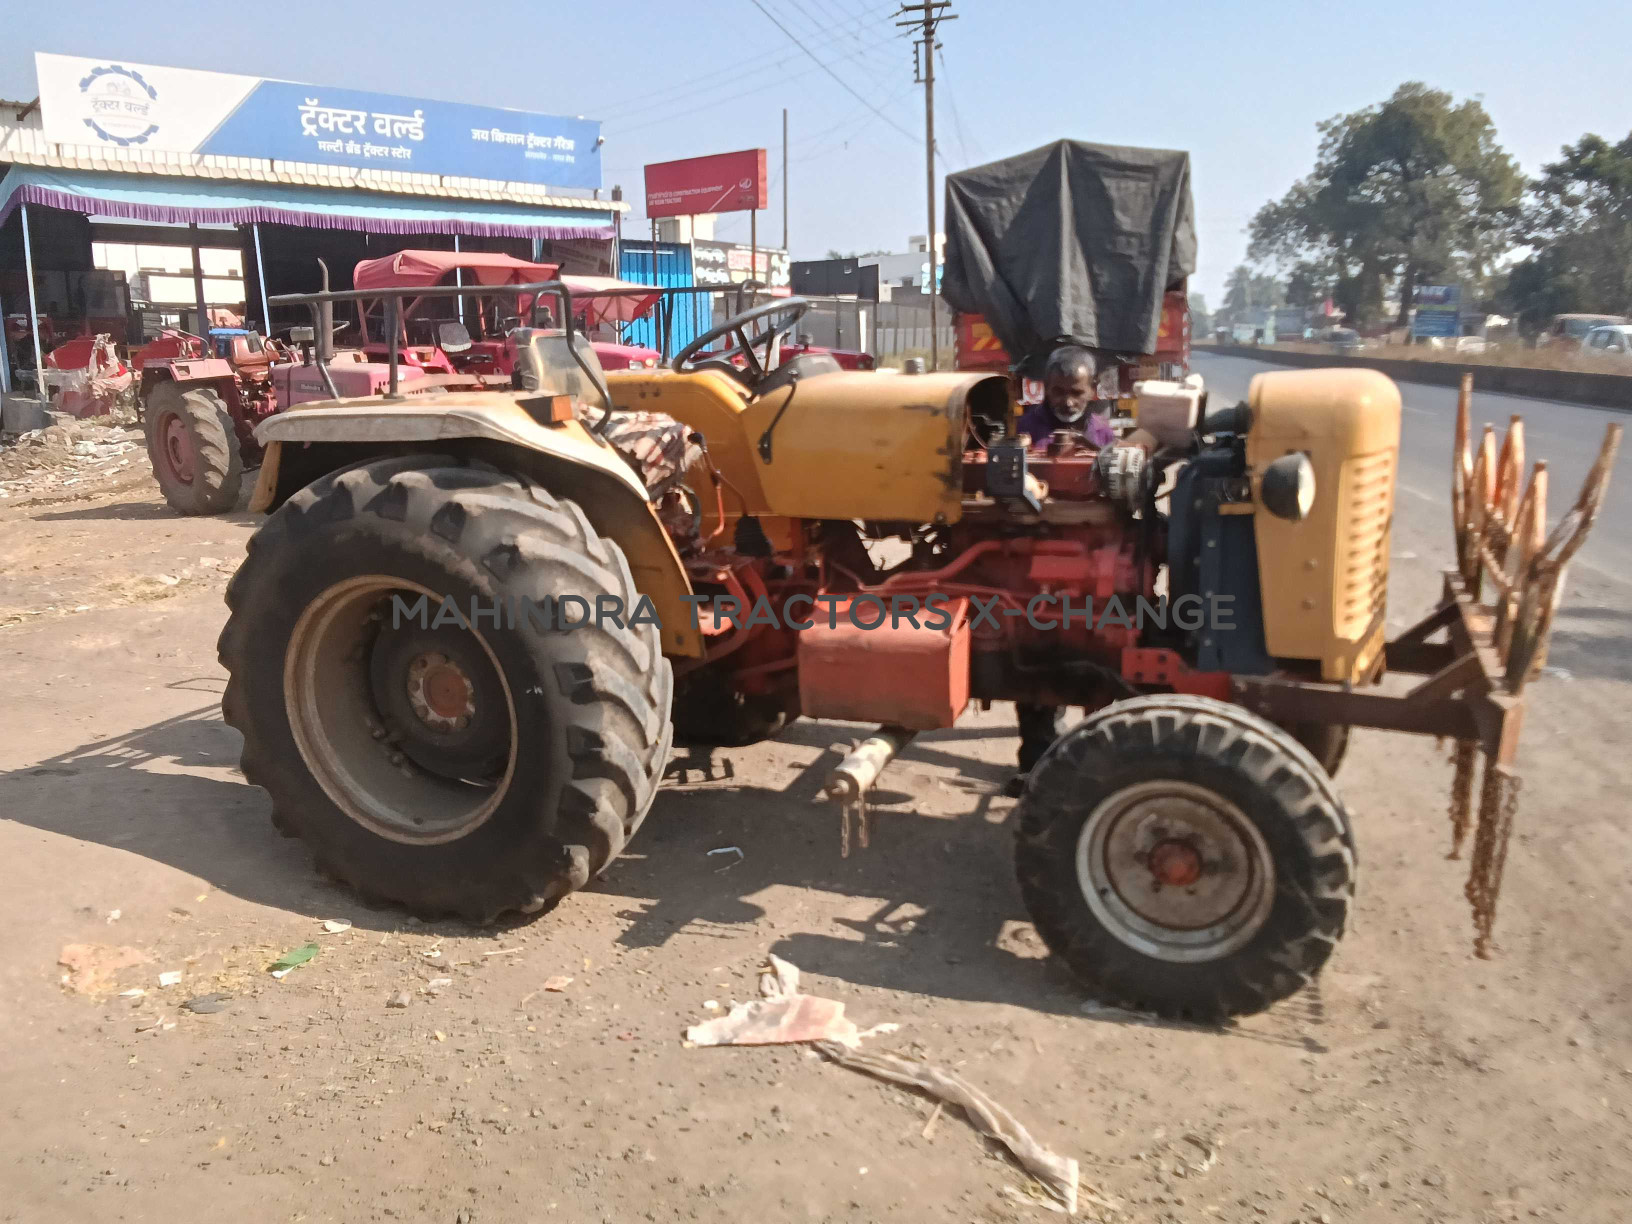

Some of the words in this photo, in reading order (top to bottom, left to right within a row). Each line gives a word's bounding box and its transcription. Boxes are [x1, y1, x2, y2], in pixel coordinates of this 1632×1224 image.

[298, 97, 368, 137] ट्रॅक्टर
[371, 109, 425, 142] वर्ल्ड
[471, 128, 489, 141] जय
[490, 128, 525, 145] किसान
[317, 139, 343, 152] मल्टी
[390, 145, 412, 160] स्टोर
